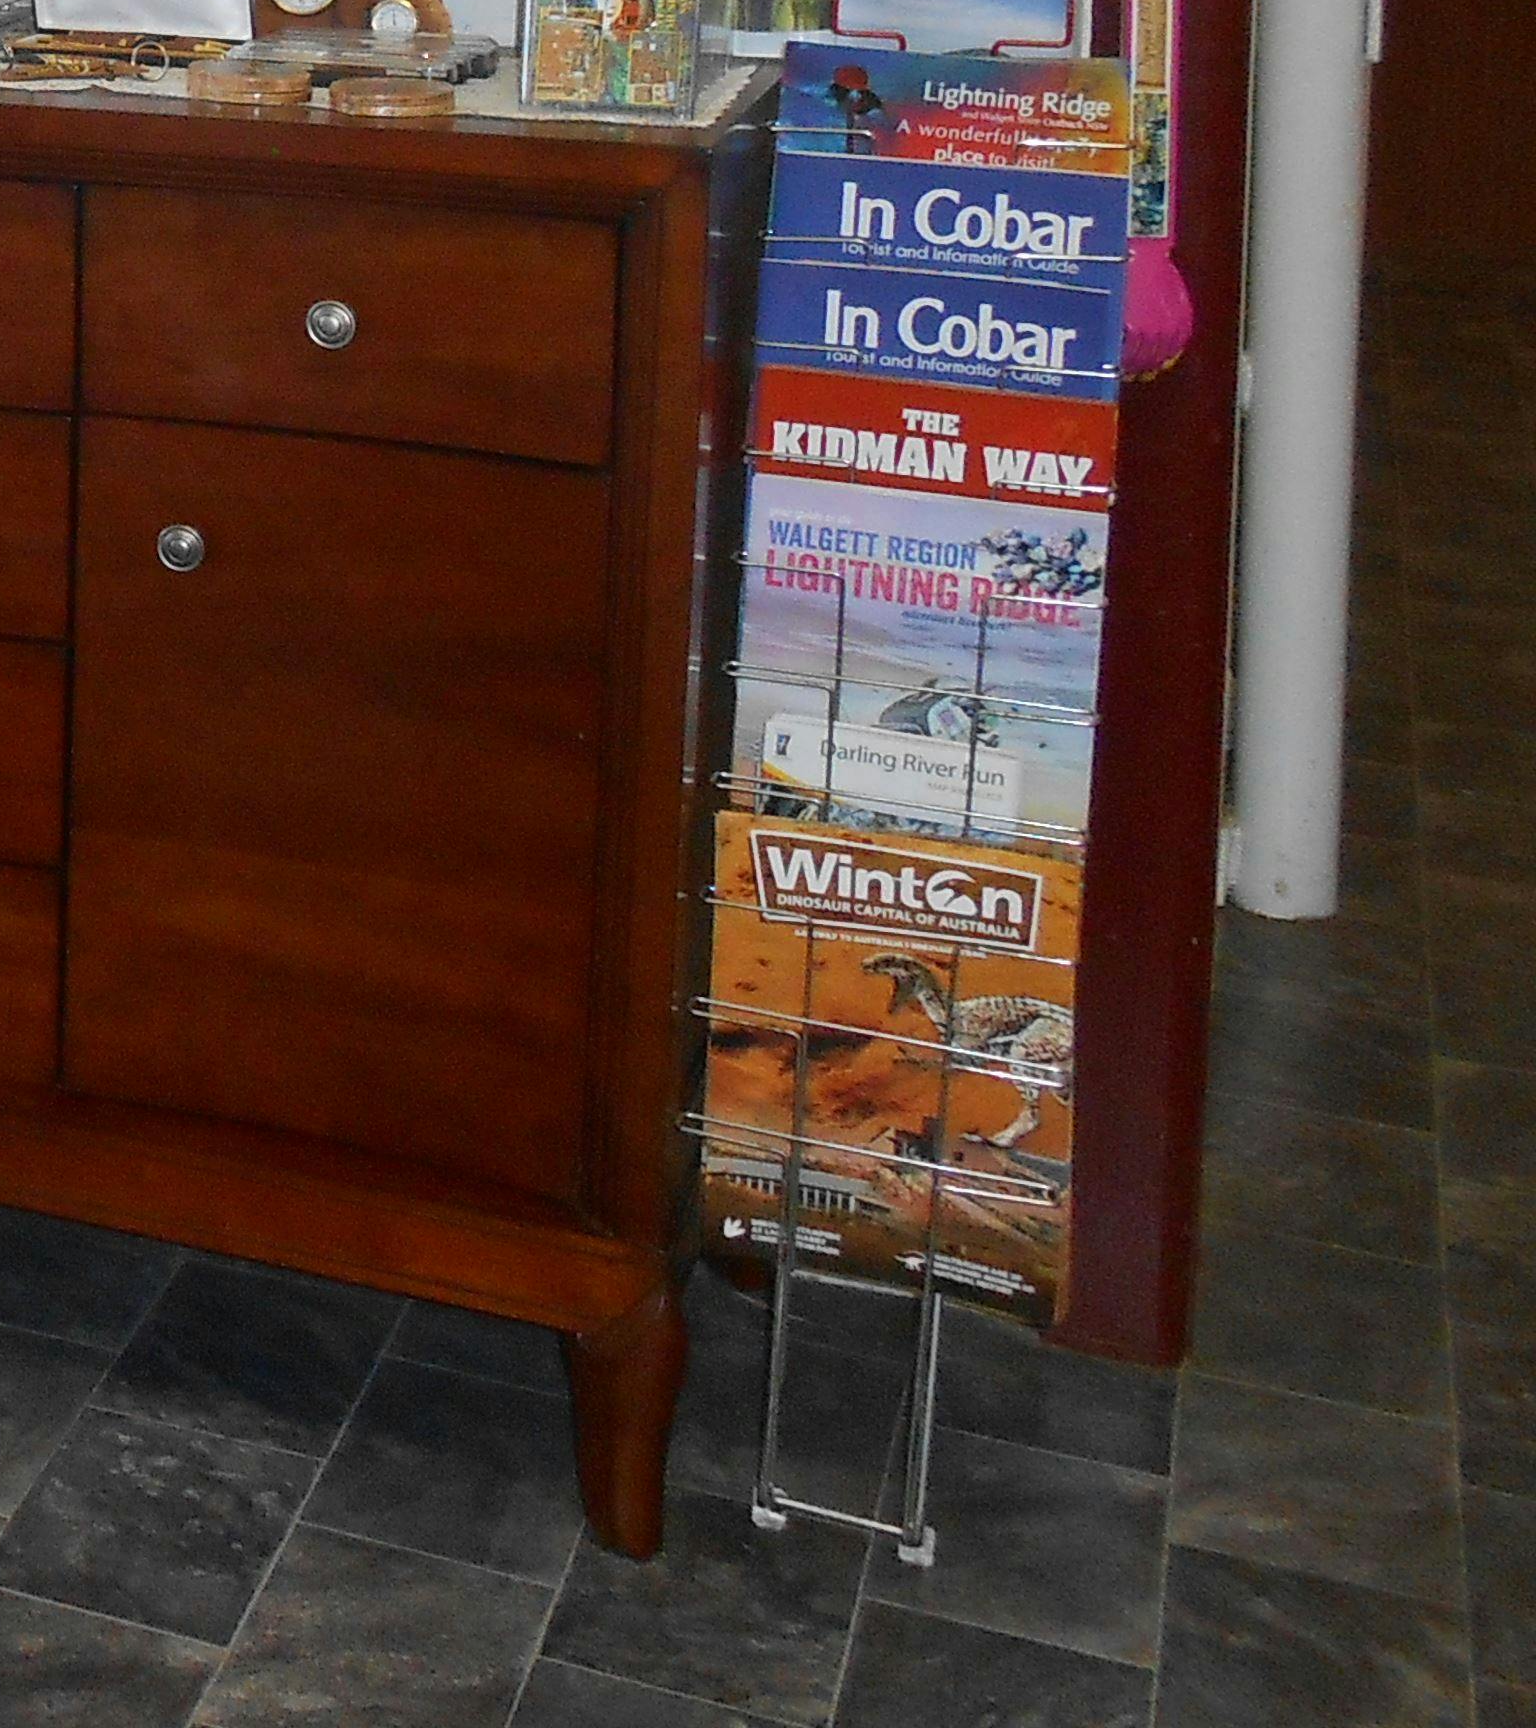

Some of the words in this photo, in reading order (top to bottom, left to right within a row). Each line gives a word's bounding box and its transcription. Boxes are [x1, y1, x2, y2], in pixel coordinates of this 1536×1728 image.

[923, 81, 1035, 117] Lightning
[1041, 92, 1111, 122] Ridge
[896, 119, 911, 134] A
[935, 143, 984, 164] place
[989, 154, 1007, 167] to
[840, 181, 895, 240] In
[913, 187, 1094, 258] Cobar
[896, 244, 928, 260] and
[824, 290, 879, 348] In
[898, 296, 1077, 369] Cobar
[879, 354, 912, 369] and
[902, 408, 960, 436] THE
[773, 421, 967, 483] KIDMAN
[984, 446, 1093, 496] WAY
[769, 520, 879, 558] WALGETT
[887, 535, 977, 571] REGION
[765, 550, 958, 613] LIGHTNING
[902, 753, 958, 777] River
[777, 893, 851, 914] DINOSAUR
[854, 903, 911, 922] CAPITAL
[916, 913, 936, 925] OF
[939, 916, 1020, 940] AUSTRALIA
